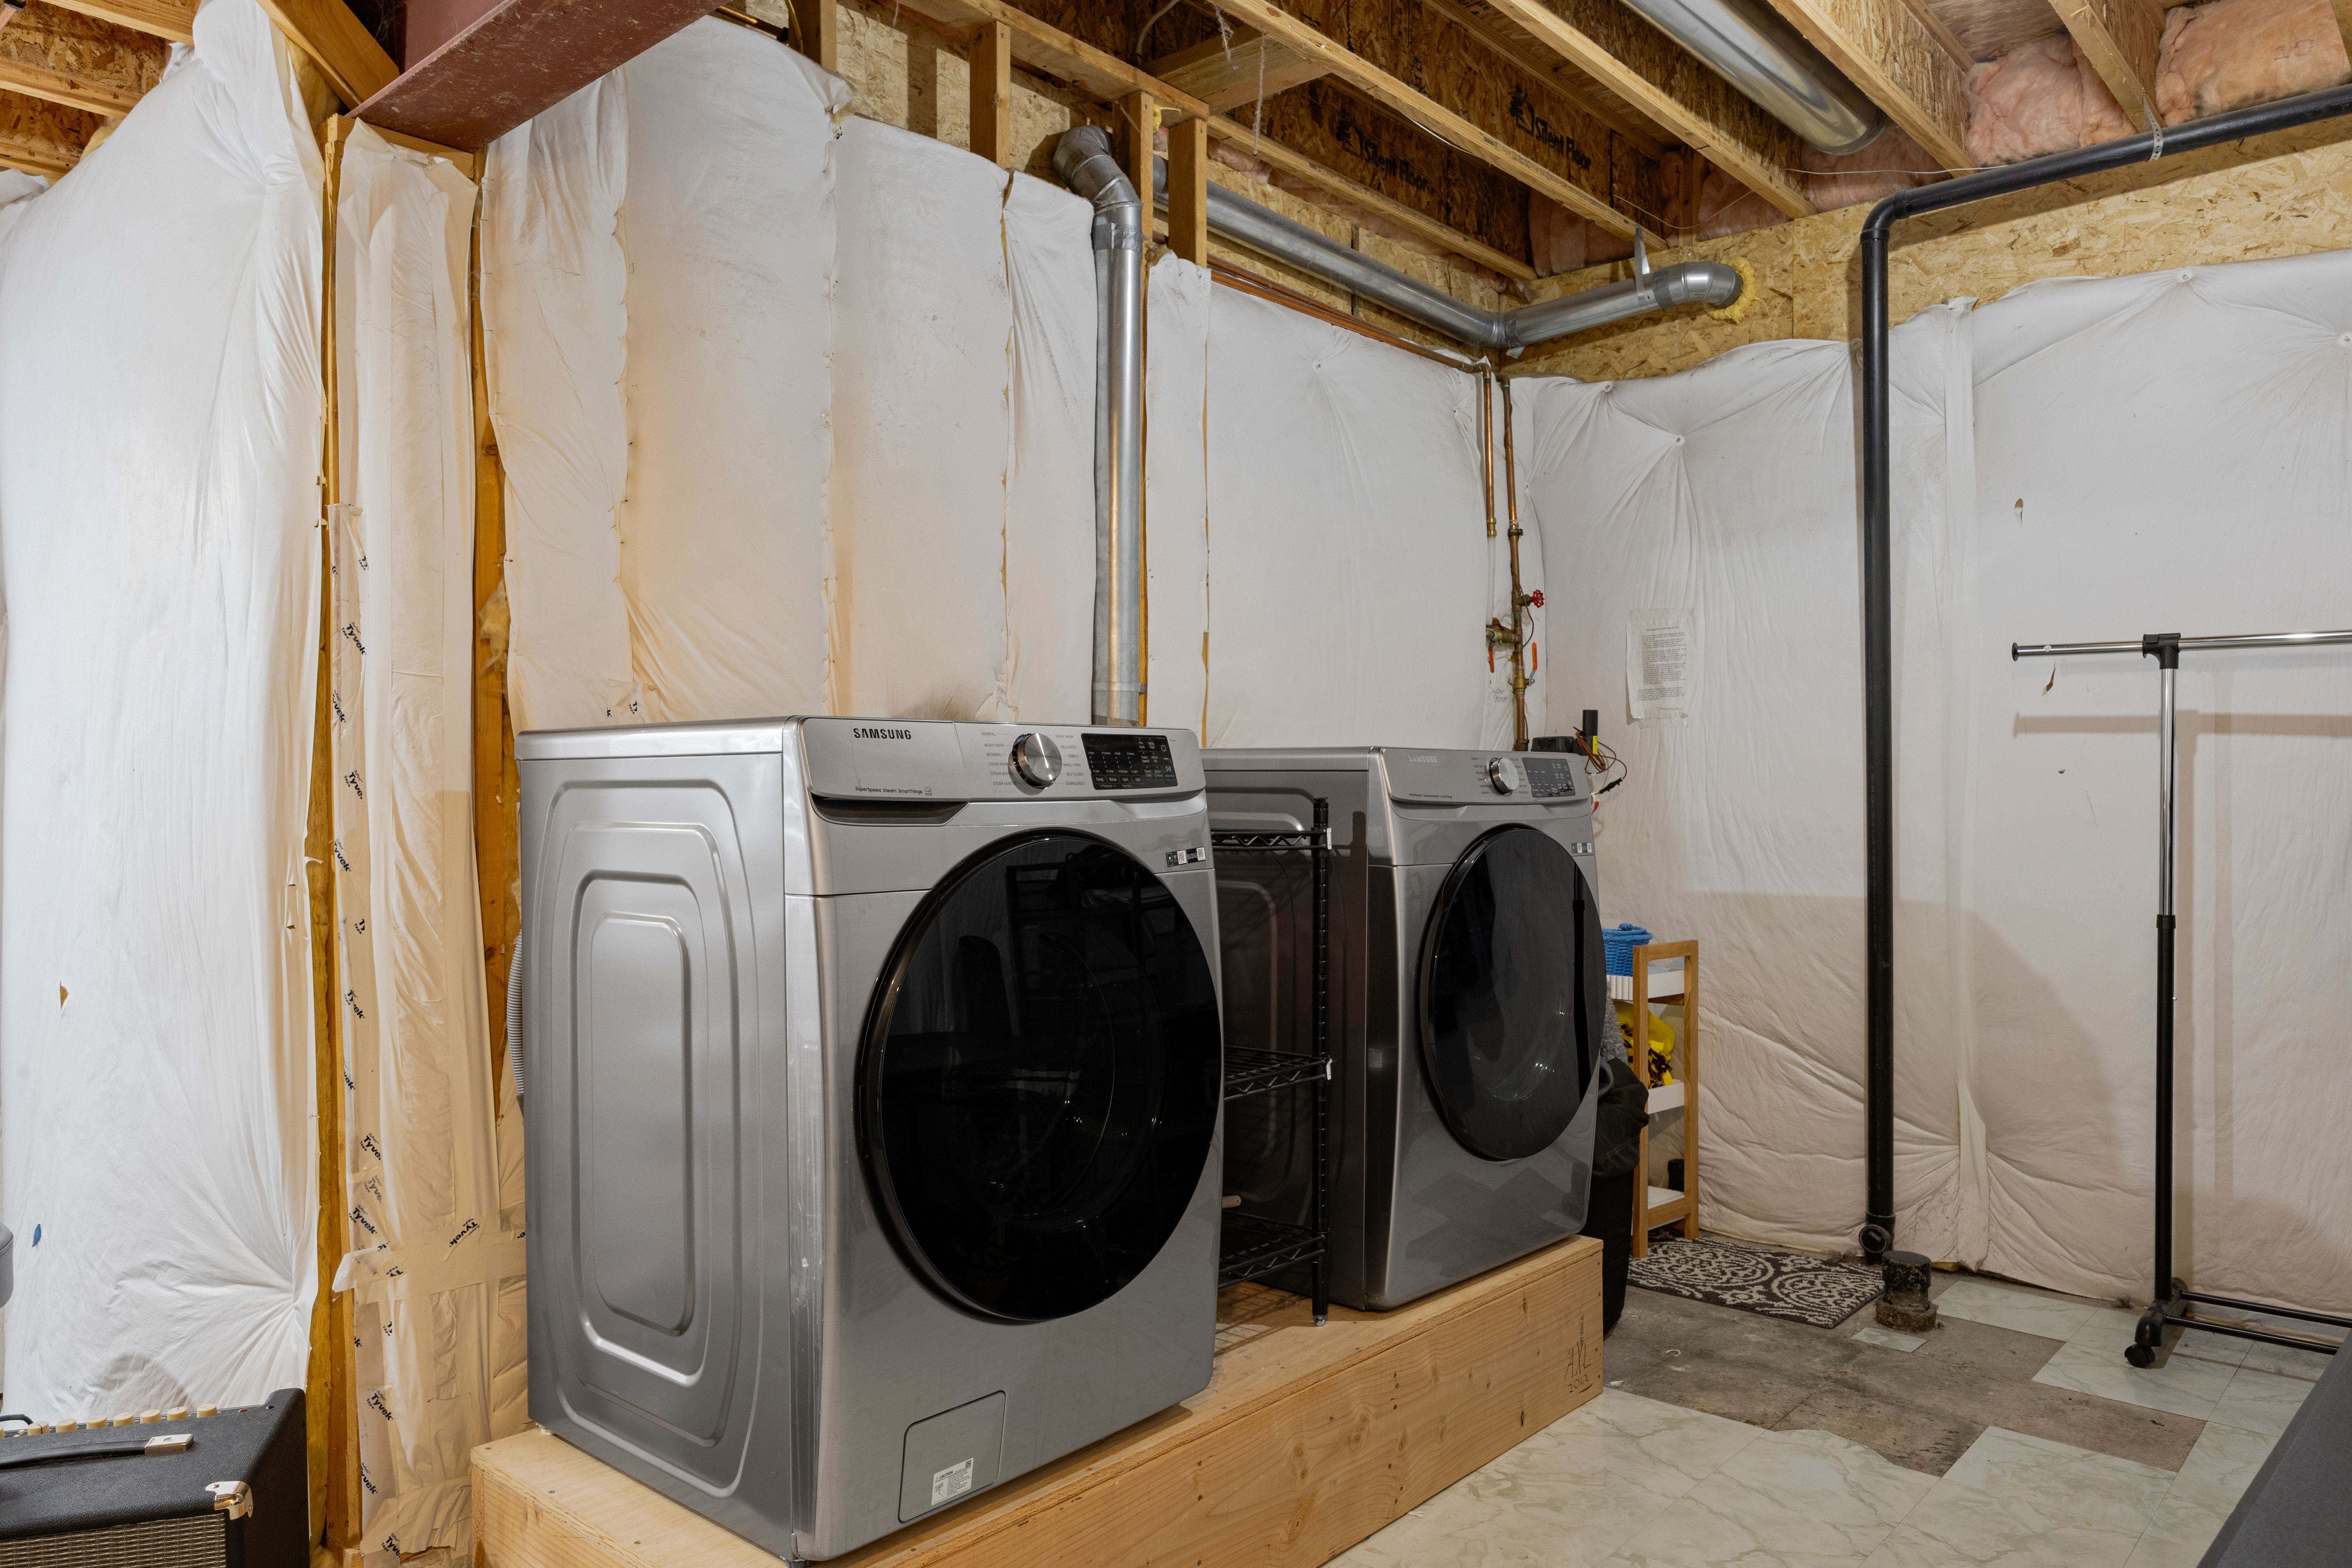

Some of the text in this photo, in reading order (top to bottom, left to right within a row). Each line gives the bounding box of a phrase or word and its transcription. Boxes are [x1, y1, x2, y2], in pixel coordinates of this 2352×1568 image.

[347, 624, 366, 655] Tyvek
[853, 728, 911, 740] SAMSUNG
[349, 772, 363, 800] Tyve
[364, 1135, 381, 1161] Tyve
[368, 1132, 379, 1144] DuPont
[368, 1177, 382, 1204] Tyve
[353, 1207, 377, 1234] Tyvek
[357, 1204, 368, 1215] DuPont
[463, 1218, 474, 1227] Tape
[449, 1221, 478, 1247] Tyvek
[386, 1265, 398, 1275] Tape
[1564, 1341, 1592, 1380] AXL
[1567, 1375, 1589, 1393] 2022
[366, 1398, 374, 1409] Tape
[371, 1393, 393, 1421] Tyvek
[939, 1470, 954, 1479] CAUTION
[386, 1536, 400, 1558] Tyve
